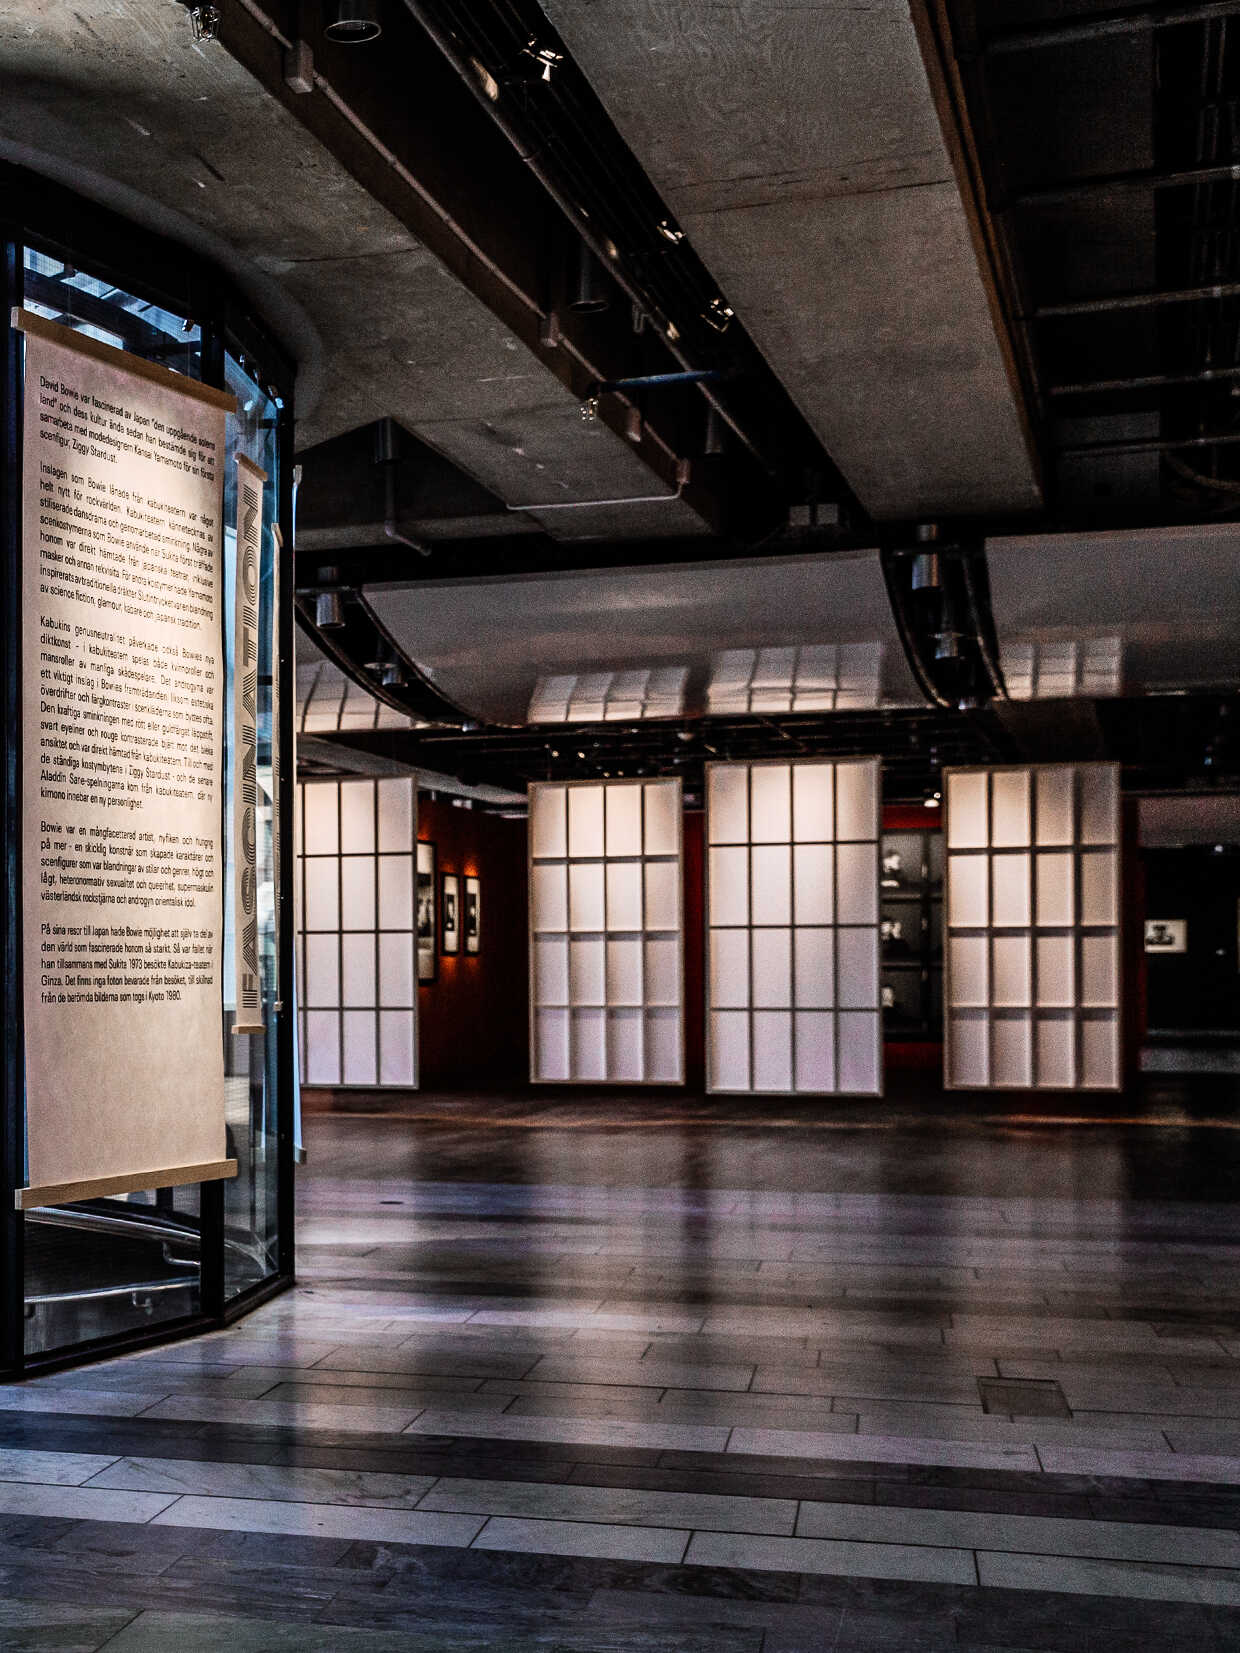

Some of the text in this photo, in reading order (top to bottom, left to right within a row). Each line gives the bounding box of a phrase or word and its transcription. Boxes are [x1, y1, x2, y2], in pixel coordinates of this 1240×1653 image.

[39, 375, 58, 392] David
[60, 383, 78, 400] Bowie
[80, 393, 90, 404] var
[59, 402, 71, 414] och
[73, 404, 88, 420] dess
[39, 412, 72, 431] samarbeta
[74, 424, 87, 436] med
[72, 437, 89, 457] Ziggy
[40, 477, 82, 501] helt nytt för
[70, 473, 84, 485] som
[86, 476, 106, 492] Bowie
[40, 529, 96, 555] honom var direkt
[92, 530, 105, 541] som
[40, 549, 76, 566] masker och
[40, 583, 48, 592] av
[50, 584, 74, 599] science
[40, 614, 72, 632] Kabukins
[40, 632, 73, 649] diktkonst
[40, 652, 75, 666] mansroller
[78, 660, 86, 669] av
[40, 668, 50, 678] ett
[52, 669, 73, 685] viktigt
[40, 683, 89, 702] överdrifter och
[40, 700, 55, 713] Den
[56, 703, 80, 720] kraftiga
[40, 720, 58, 730] svart
[87, 726, 98, 737] och
[40, 736, 107, 755] ansiktet och var direkt
[242, 484, 259, 1008] FASCINATION
[40, 752, 50, 763] de
[52, 754, 79, 770] ständiga
[40, 769, 66, 782] Aladdin
[40, 786, 65, 799] kimono
[90, 795, 98, 803] en
[98, 796, 106, 807] ny
[40, 820, 62, 833] Bowie
[65, 826, 76, 834] var
[78, 827, 86, 835] en
[40, 838, 50, 851] på
[53, 842, 66, 850] mer
[74, 843, 82, 851] en
[40, 856, 77, 870] scenfigurer
[78, 860, 91, 868] som
[136, 878, 146, 888] och
[40, 889, 81, 901] västerländsk
[116, 893, 126, 903] och
[40, 923, 50, 934] På
[52, 924, 66, 934] sina
[67, 927, 81, 935] resor
[40, 940, 55, 951] den
[56, 941, 72, 951] värld
[88, 941, 123, 952] fascinerade
[40, 958, 55, 968] han
[93, 958, 107, 968] med
[108, 958, 127, 968] Sukita
[64, 975, 75, 985] Det
[76, 975, 91, 985] finns
[92, 975, 105, 988] inga
[40, 992, 56, 1002] från
[57, 992, 65, 1002] de
[94, 991, 118, 1001] bilderna
